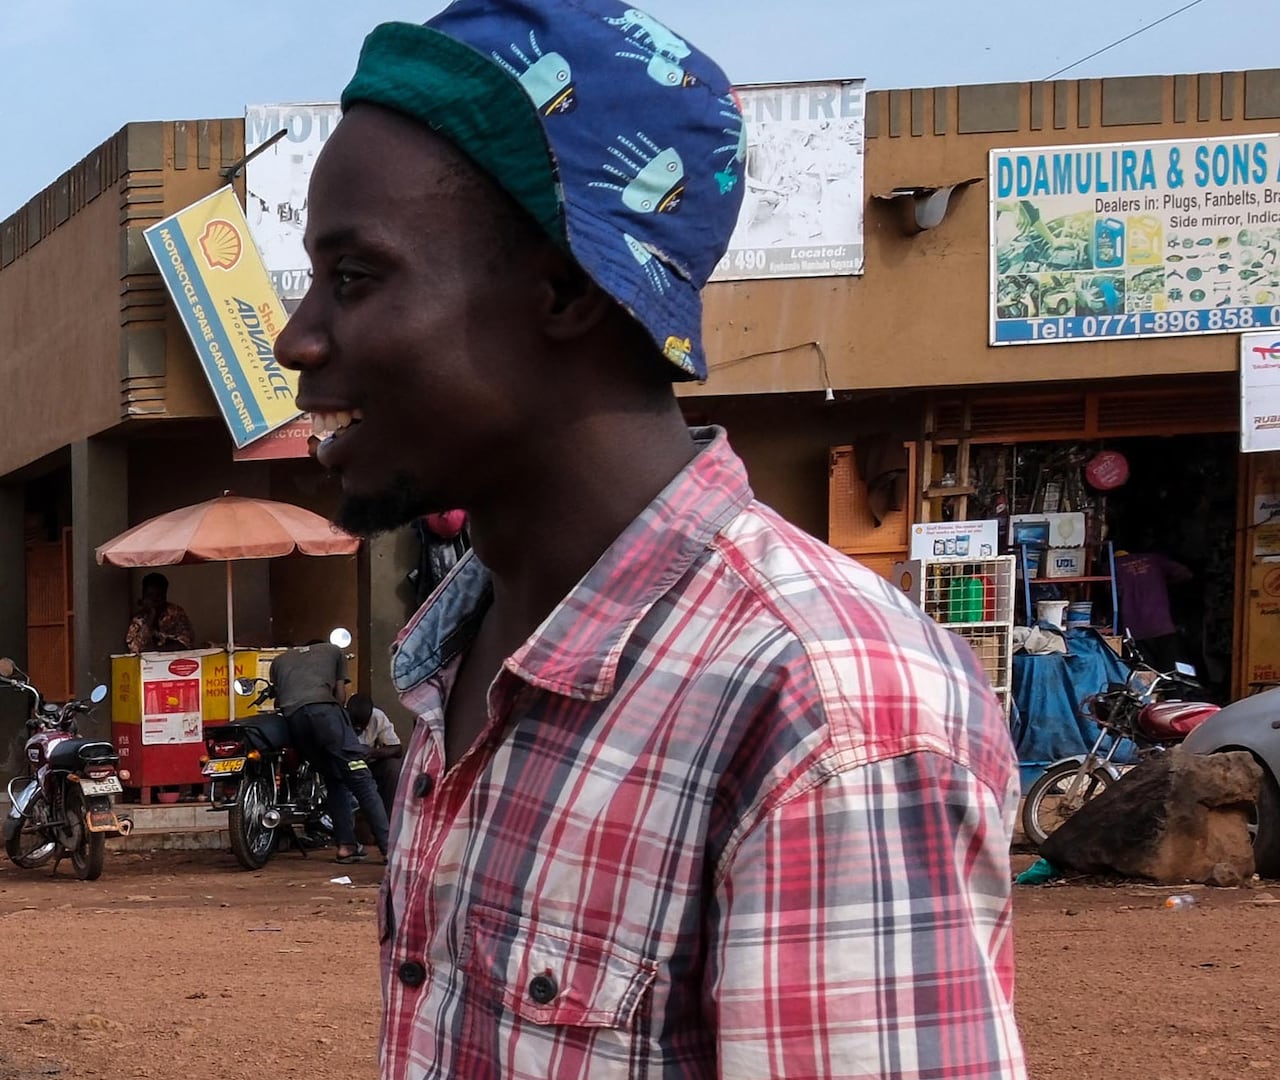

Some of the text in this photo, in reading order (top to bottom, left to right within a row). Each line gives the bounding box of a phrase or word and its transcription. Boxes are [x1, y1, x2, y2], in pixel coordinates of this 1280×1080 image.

[997, 149, 1156, 198] DDAMULIRA
[1166, 147, 1184, 189] &
[1194, 142, 1268, 188] SONS
[1095, 198, 1141, 214] Dealers
[1144, 196, 1159, 210] in:
[1163, 193, 1201, 213] Plugs,
[1205, 190, 1260, 208] Fanbelts,
[1170, 215, 1198, 229] Side
[1201, 215, 1243, 227] mirror,
[735, 249, 767, 270] 490
[790, 246, 846, 259] Located:
[159, 229, 256, 433] MOTORCYCLE SPARE GARAGE CENTRE
[258, 302, 281, 338] Shel
[1027, 319, 1073, 339] Tel:
[1082, 311, 1200, 334] 0771-896
[1208, 307, 1262, 328] 858.
[224, 300, 274, 401] MOTORCYCLE OILS
[232, 297, 294, 401] ADVANCE
[214, 664, 244, 676] MN
